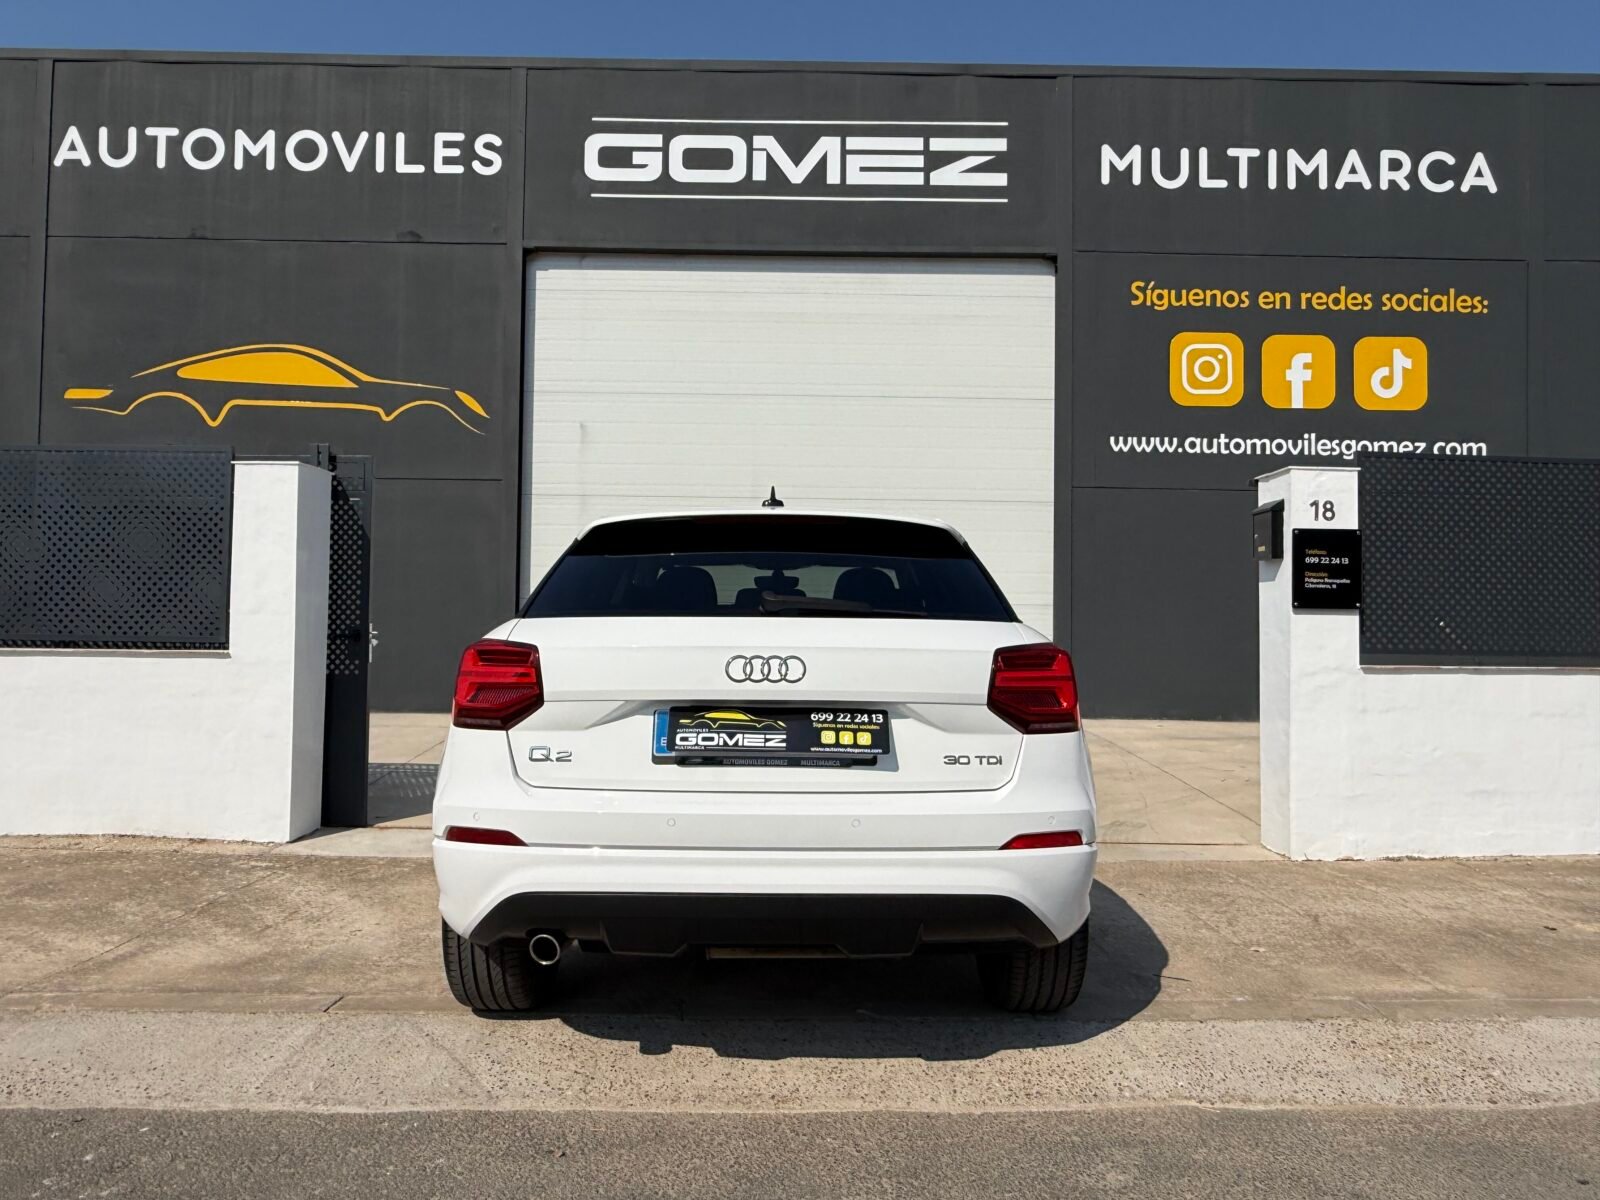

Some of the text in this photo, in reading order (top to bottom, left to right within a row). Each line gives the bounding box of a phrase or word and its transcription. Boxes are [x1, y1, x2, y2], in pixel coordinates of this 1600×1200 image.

[53, 125, 503, 176] AUTOMOVILES
[584, 132, 1008, 188] GOMEZ
[1100, 143, 1498, 194] MULTIMARCA
[1130, 280, 1489, 314] Síguenos en redes sociales:
[1109, 432, 1487, 460] www.automovilesgomezcom
[1309, 500, 1336, 521] 18
[810, 712, 883, 723] 699 22 24 13
[675, 733, 787, 747] GOMEZ
[528, 745, 573, 763] Q2
[943, 755, 1003, 765] 30 TDI
